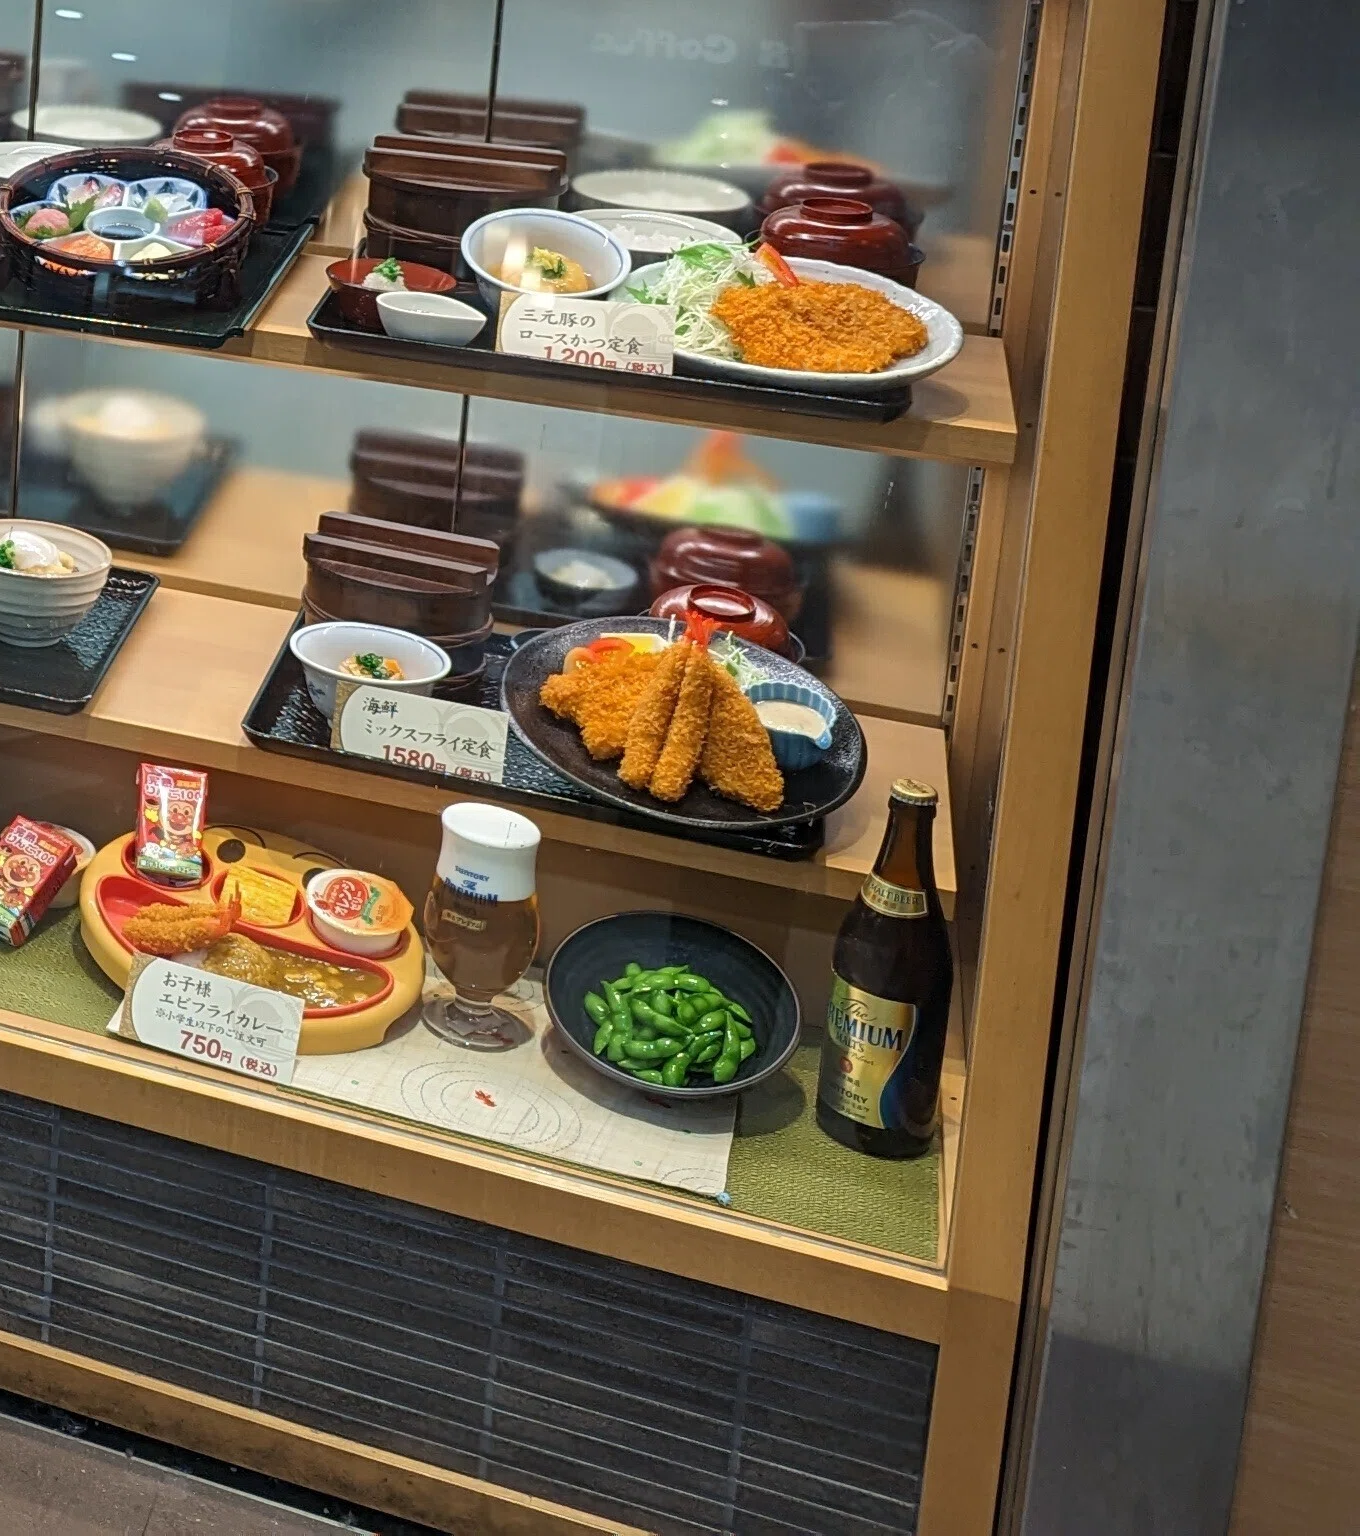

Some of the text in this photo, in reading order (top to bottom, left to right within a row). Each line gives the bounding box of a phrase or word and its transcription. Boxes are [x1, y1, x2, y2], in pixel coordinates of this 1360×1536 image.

[518, 308, 596, 329] 三元豚の
[519, 329, 644, 356] ロースかつ定食
[362, 696, 399, 719] 海鮮
[364, 718, 496, 760] ミックスフライ定食
[162, 969, 212, 999] お子様
[158, 991, 285, 1036] エビフライカレー
[837, 997, 878, 1022] The
[179, 1029, 278, 1077] 750円（税込）
